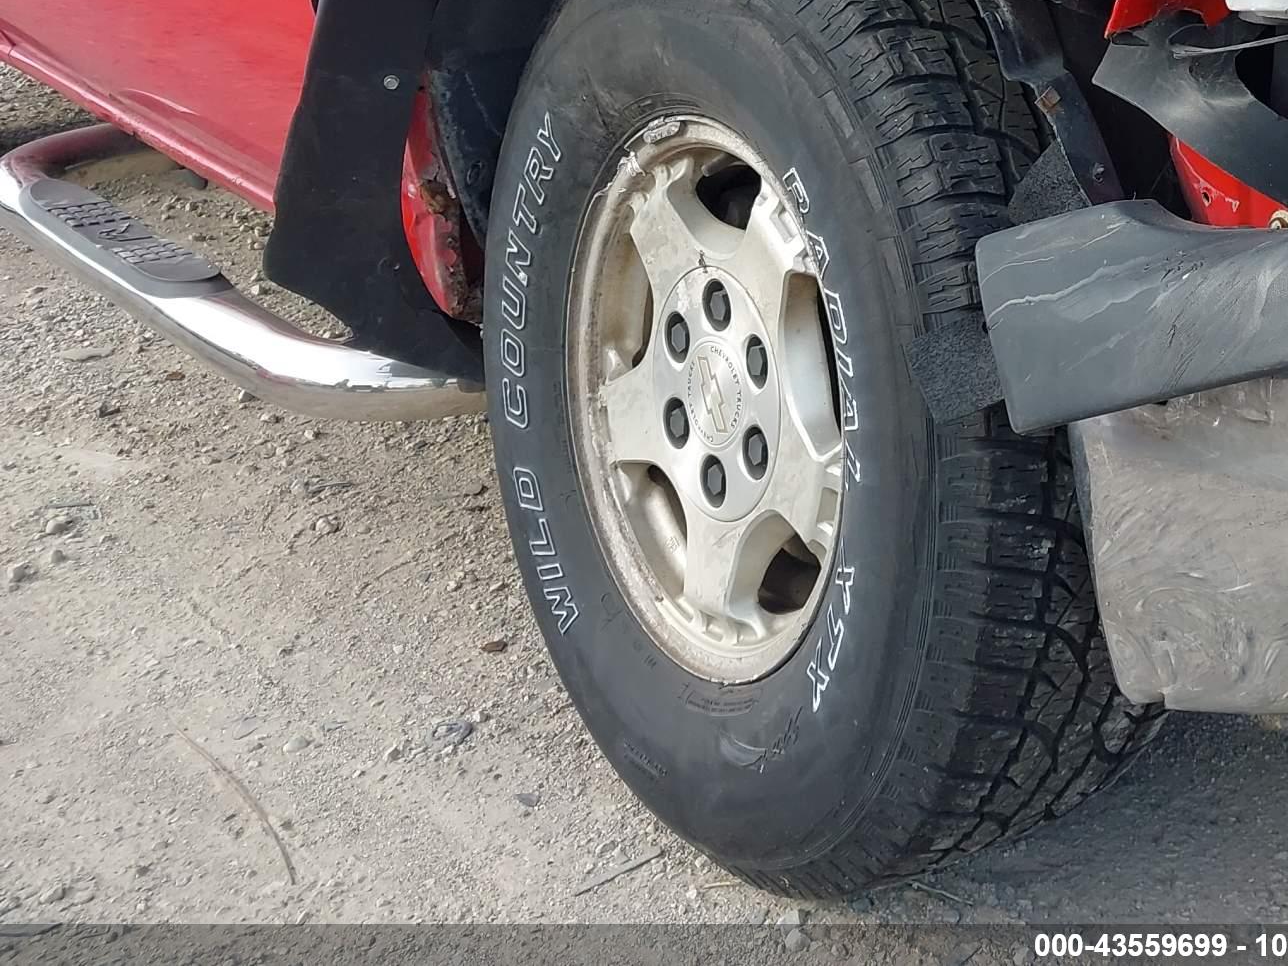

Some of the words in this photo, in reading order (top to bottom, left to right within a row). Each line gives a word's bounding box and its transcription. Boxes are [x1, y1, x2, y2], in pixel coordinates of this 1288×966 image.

[501, 112, 562, 430] COUNTRY
[710, 345, 741, 386] CHEVROLET
[730, 389, 742, 429] TRUCKS
[513, 466, 580, 636] WILD
